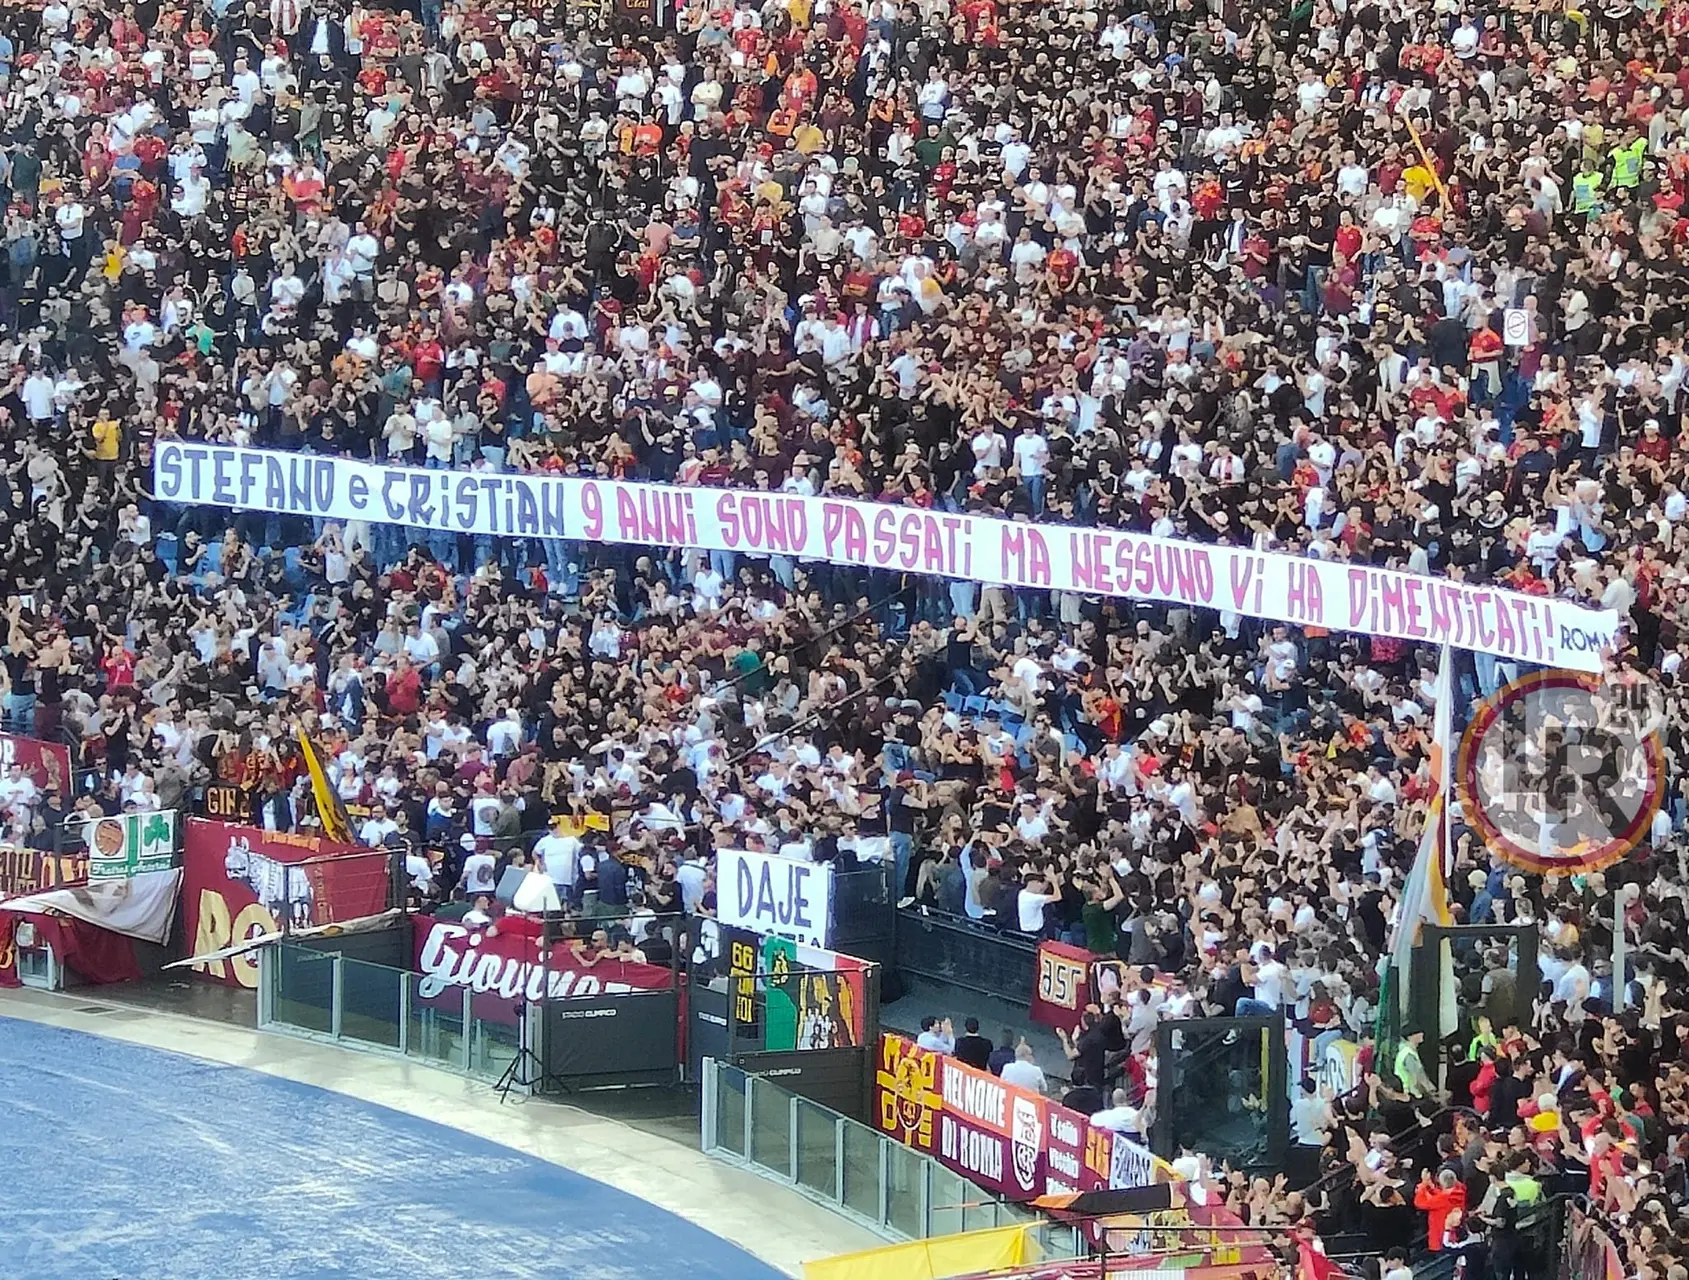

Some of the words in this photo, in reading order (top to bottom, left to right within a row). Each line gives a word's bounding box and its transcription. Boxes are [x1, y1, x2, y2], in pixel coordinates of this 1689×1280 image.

[160, 445, 335, 511] STEFANO
[348, 474, 369, 509] e
[580, 482, 604, 539] 9
[717, 498, 808, 551] SONO
[1001, 525, 1051, 586] MA
[1070, 532, 1213, 604] NESSUNO
[1287, 562, 1324, 623] HA
[737, 856, 812, 929] DAJE
[943, 1063, 964, 1112] NEL
[965, 1075, 1006, 1128] NOME
[942, 1115, 957, 1160] DI
[960, 1126, 1003, 1183] ROMA
